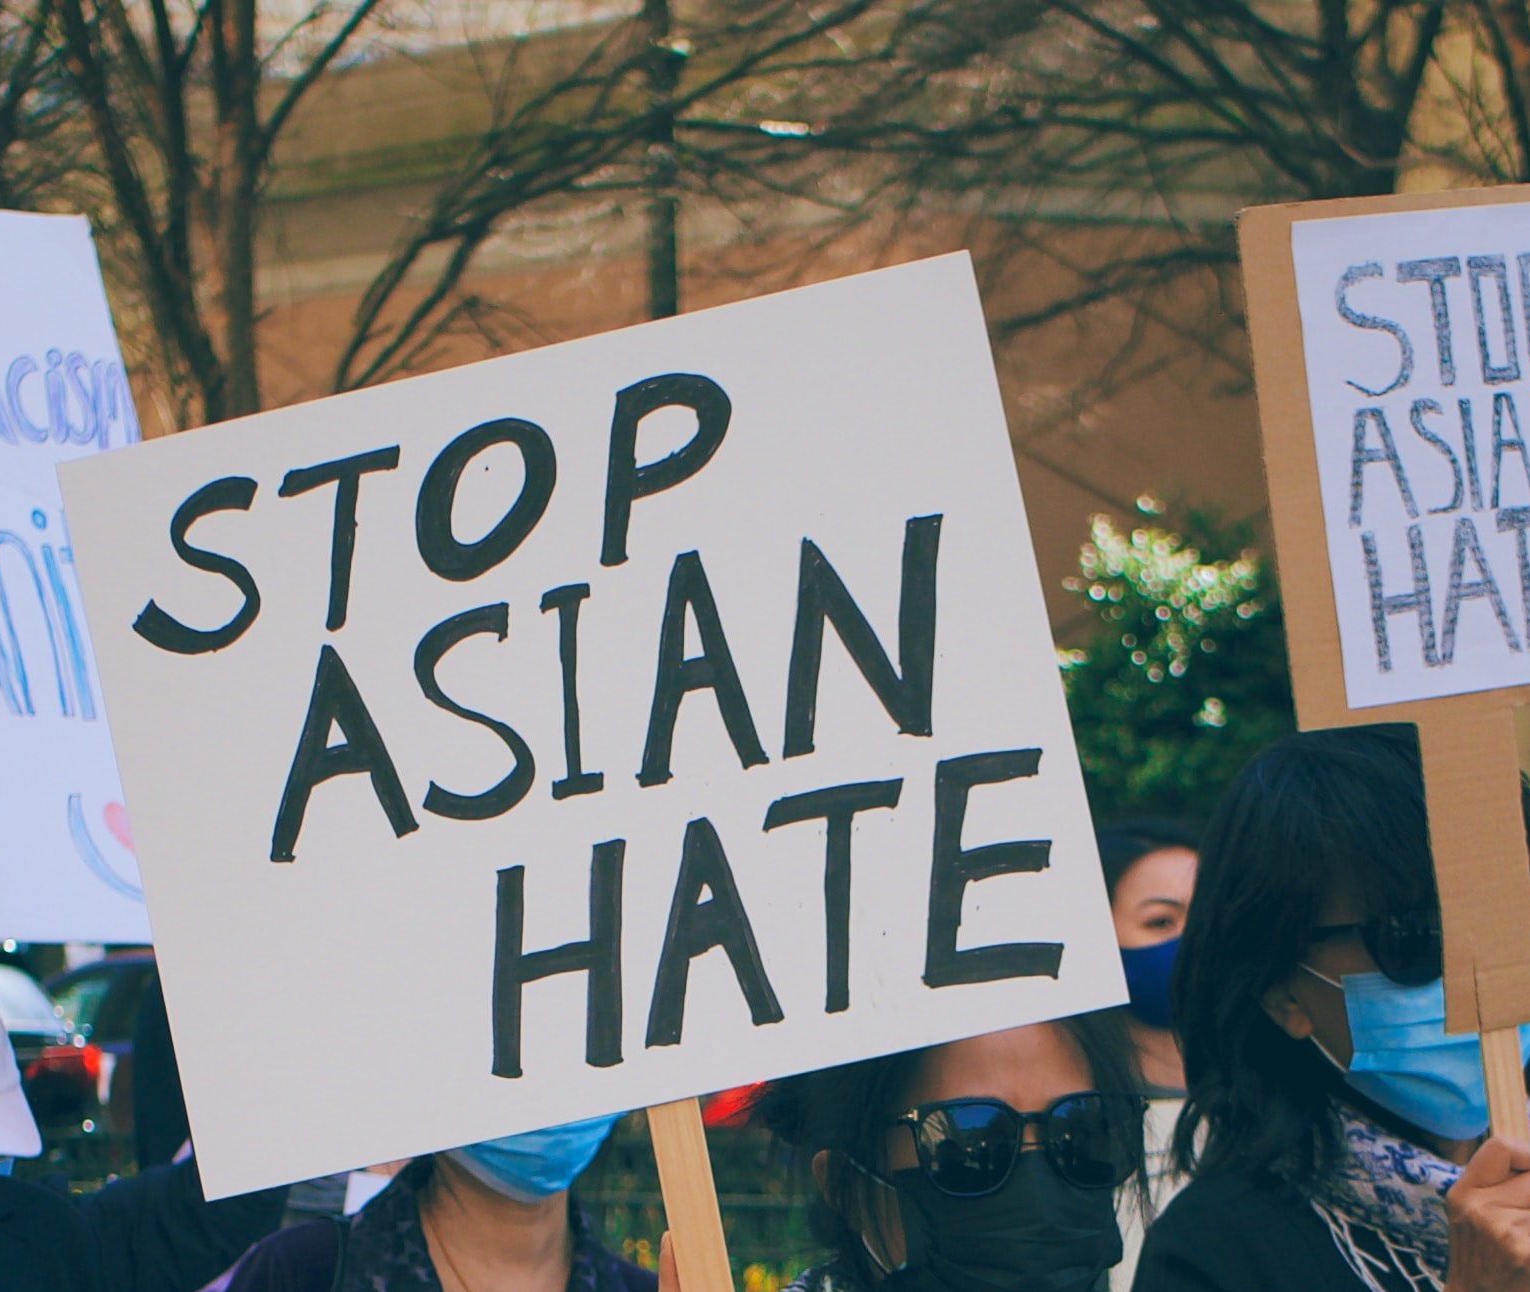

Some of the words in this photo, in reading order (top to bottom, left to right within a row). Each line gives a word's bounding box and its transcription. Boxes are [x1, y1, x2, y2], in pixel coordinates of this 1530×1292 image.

[131, 371, 733, 656] STOP
[269, 512, 944, 863] ASIAN
[491, 747, 1066, 1080] HATE
